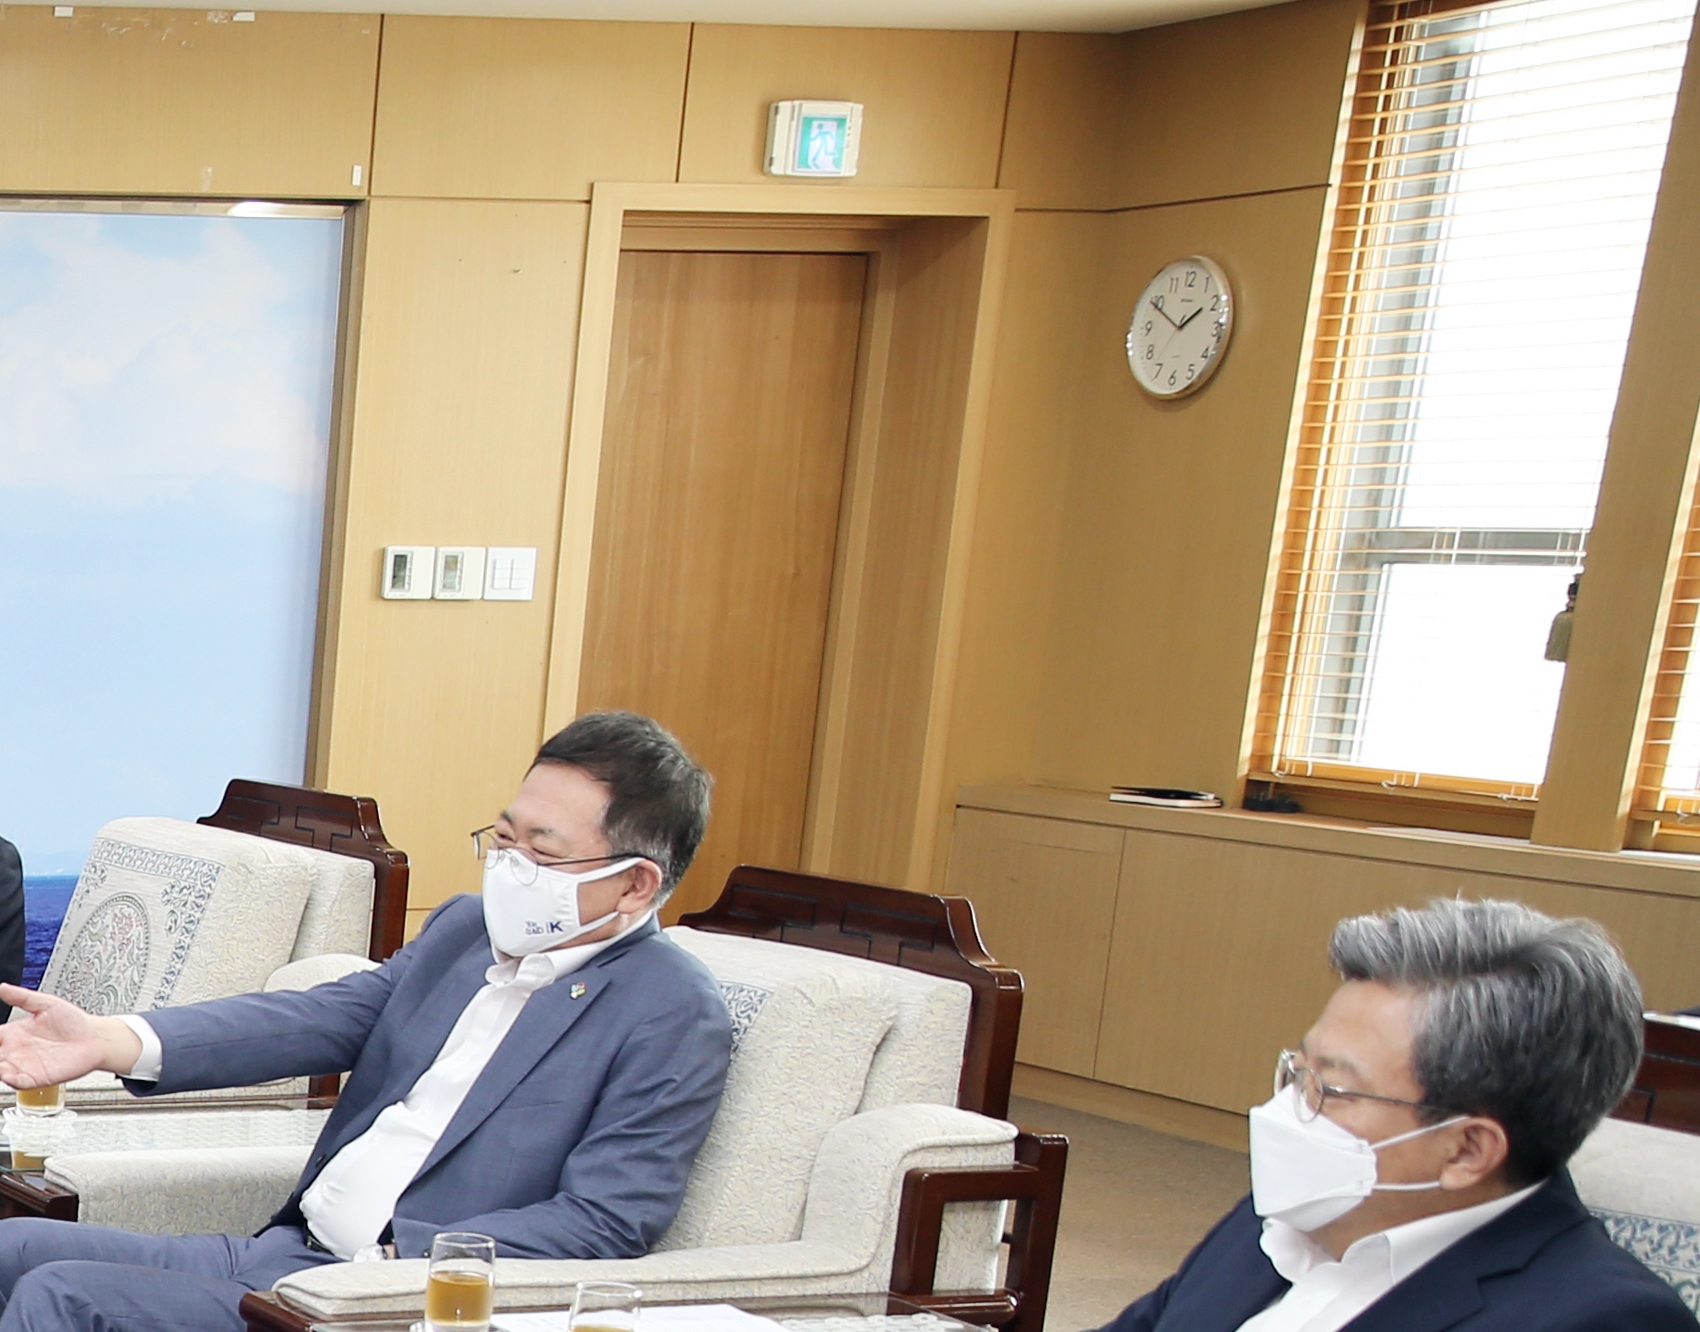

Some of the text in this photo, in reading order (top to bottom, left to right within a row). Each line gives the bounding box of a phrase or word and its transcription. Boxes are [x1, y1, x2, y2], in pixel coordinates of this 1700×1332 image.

[1184, 270, 1198, 288] 12
[1209, 294, 1219, 312] 2
[1144, 320, 1154, 337] 9
[1145, 343, 1155, 360] 8
[1200, 345, 1210, 359] 4
[1167, 369, 1178, 387] 6
[1185, 363, 1196, 380] 5
